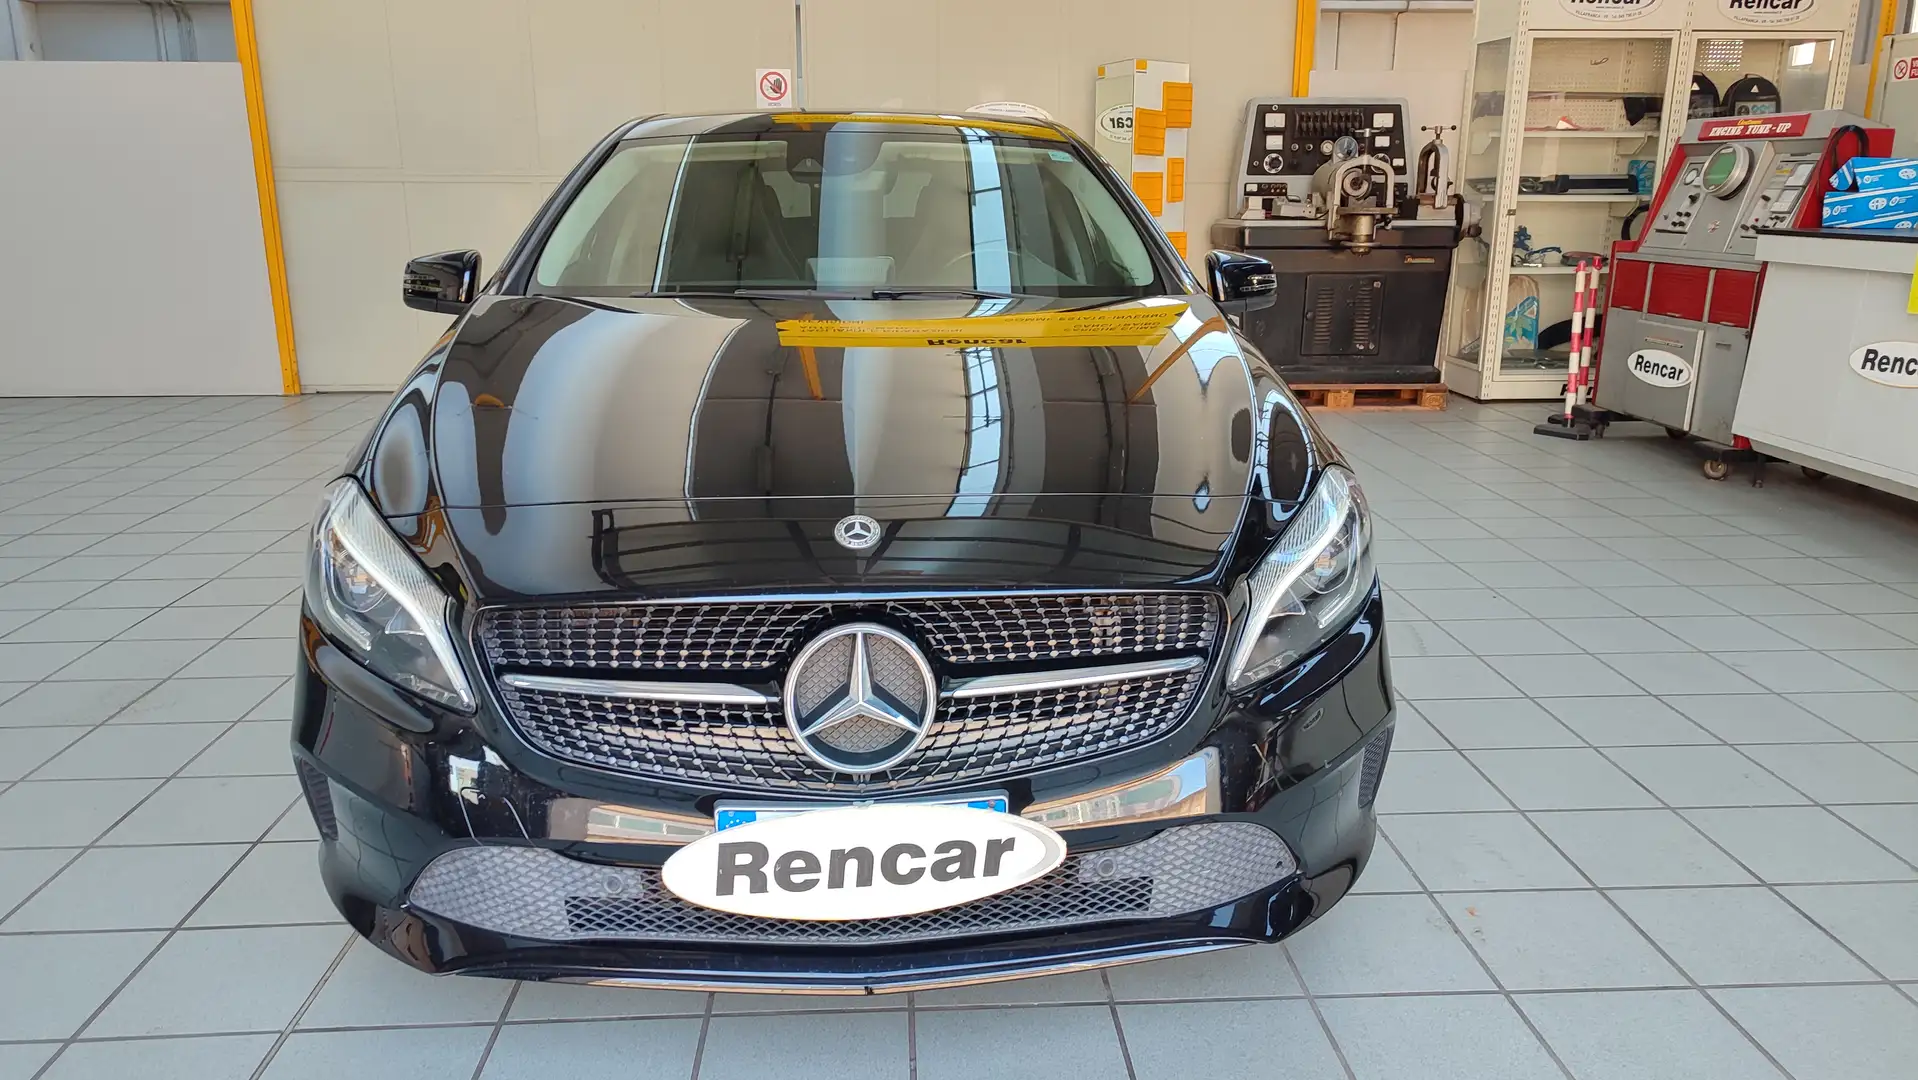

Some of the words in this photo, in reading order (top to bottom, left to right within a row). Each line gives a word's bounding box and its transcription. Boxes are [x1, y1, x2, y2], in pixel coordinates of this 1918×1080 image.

[1709, 125, 1744, 137] ENGINE
[1634, 354, 1684, 381] Rencar
[1861, 348, 1918, 376] Renc
[716, 836, 1015, 896] Rencar
